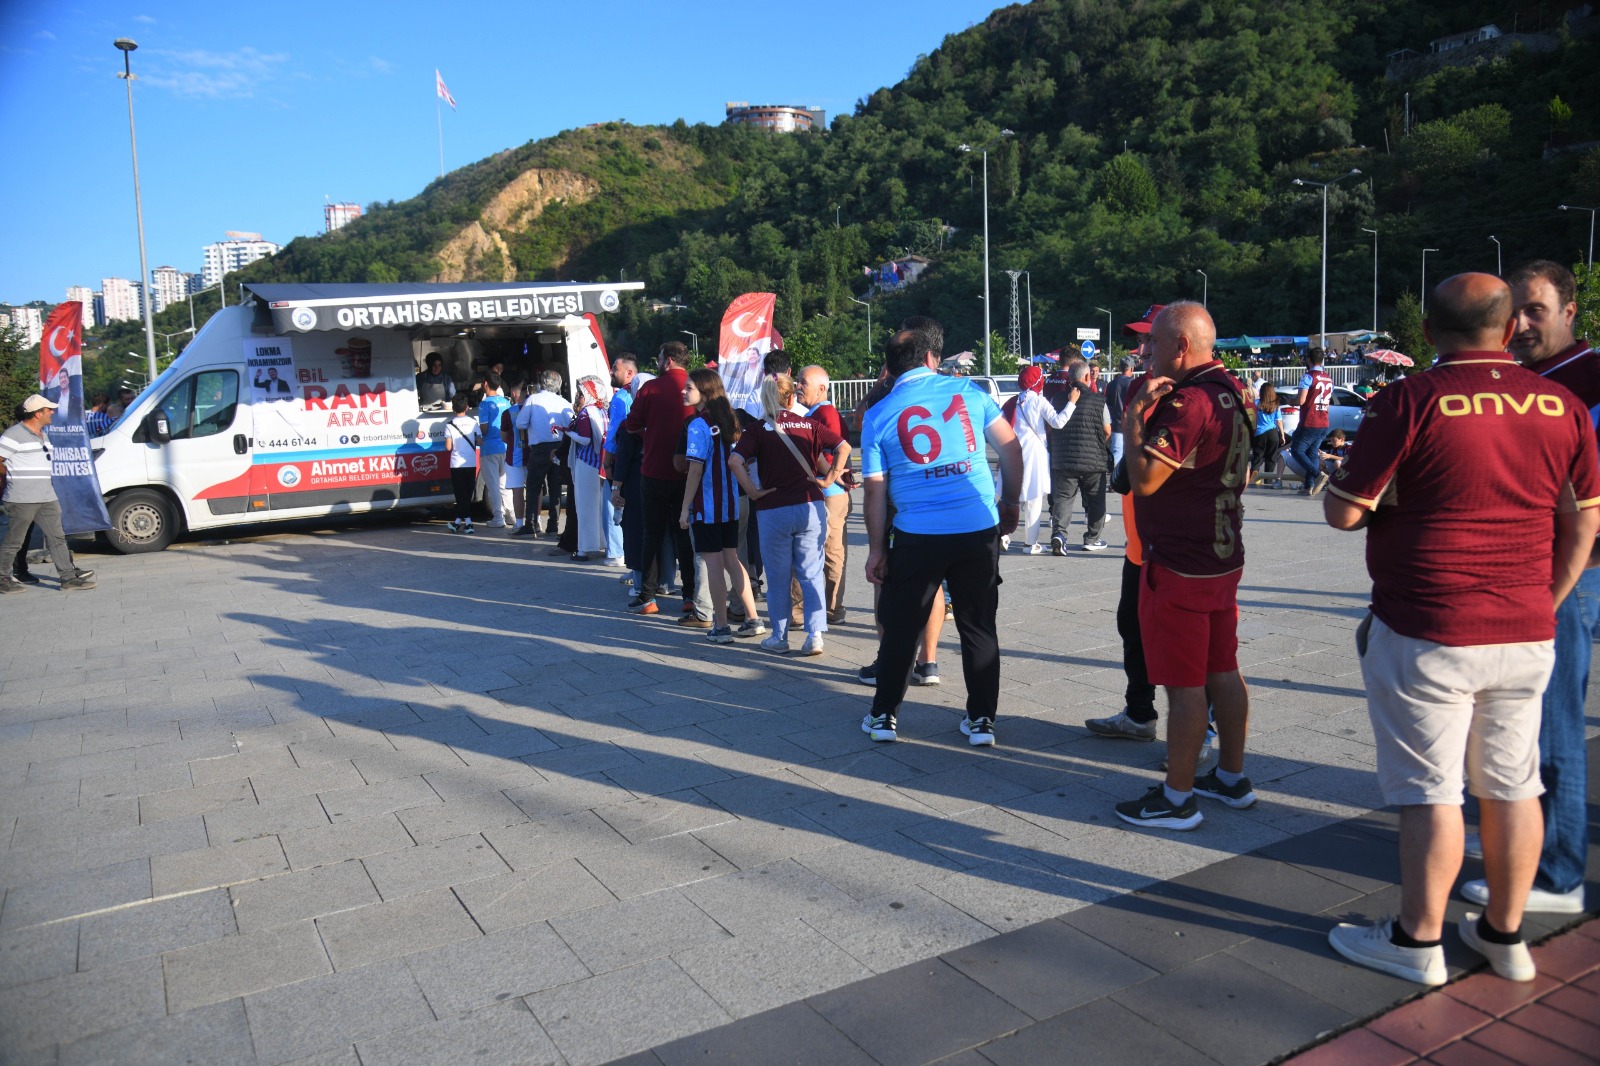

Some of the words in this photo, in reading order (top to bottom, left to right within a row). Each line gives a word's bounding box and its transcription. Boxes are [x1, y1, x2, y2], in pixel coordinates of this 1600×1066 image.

[337, 300, 463, 327] ORTAHİSAR
[468, 292, 583, 318] BELEDİYESİ
[255, 347, 281, 356] LOKMA
[299, 368, 329, 382] BİL
[303, 382, 387, 411] RAM
[1314, 381, 1333, 405] 22
[327, 410, 389, 428] ARACI
[896, 393, 977, 465] 61
[268, 439, 288, 448] 444
[311, 459, 365, 477] Ahmet
[369, 455, 407, 472] KAYA
[311, 475, 347, 485] ORTAHİSAR
[348, 473, 380, 482] BELEDİYE
[381, 471, 409, 480] BAŞKANI
